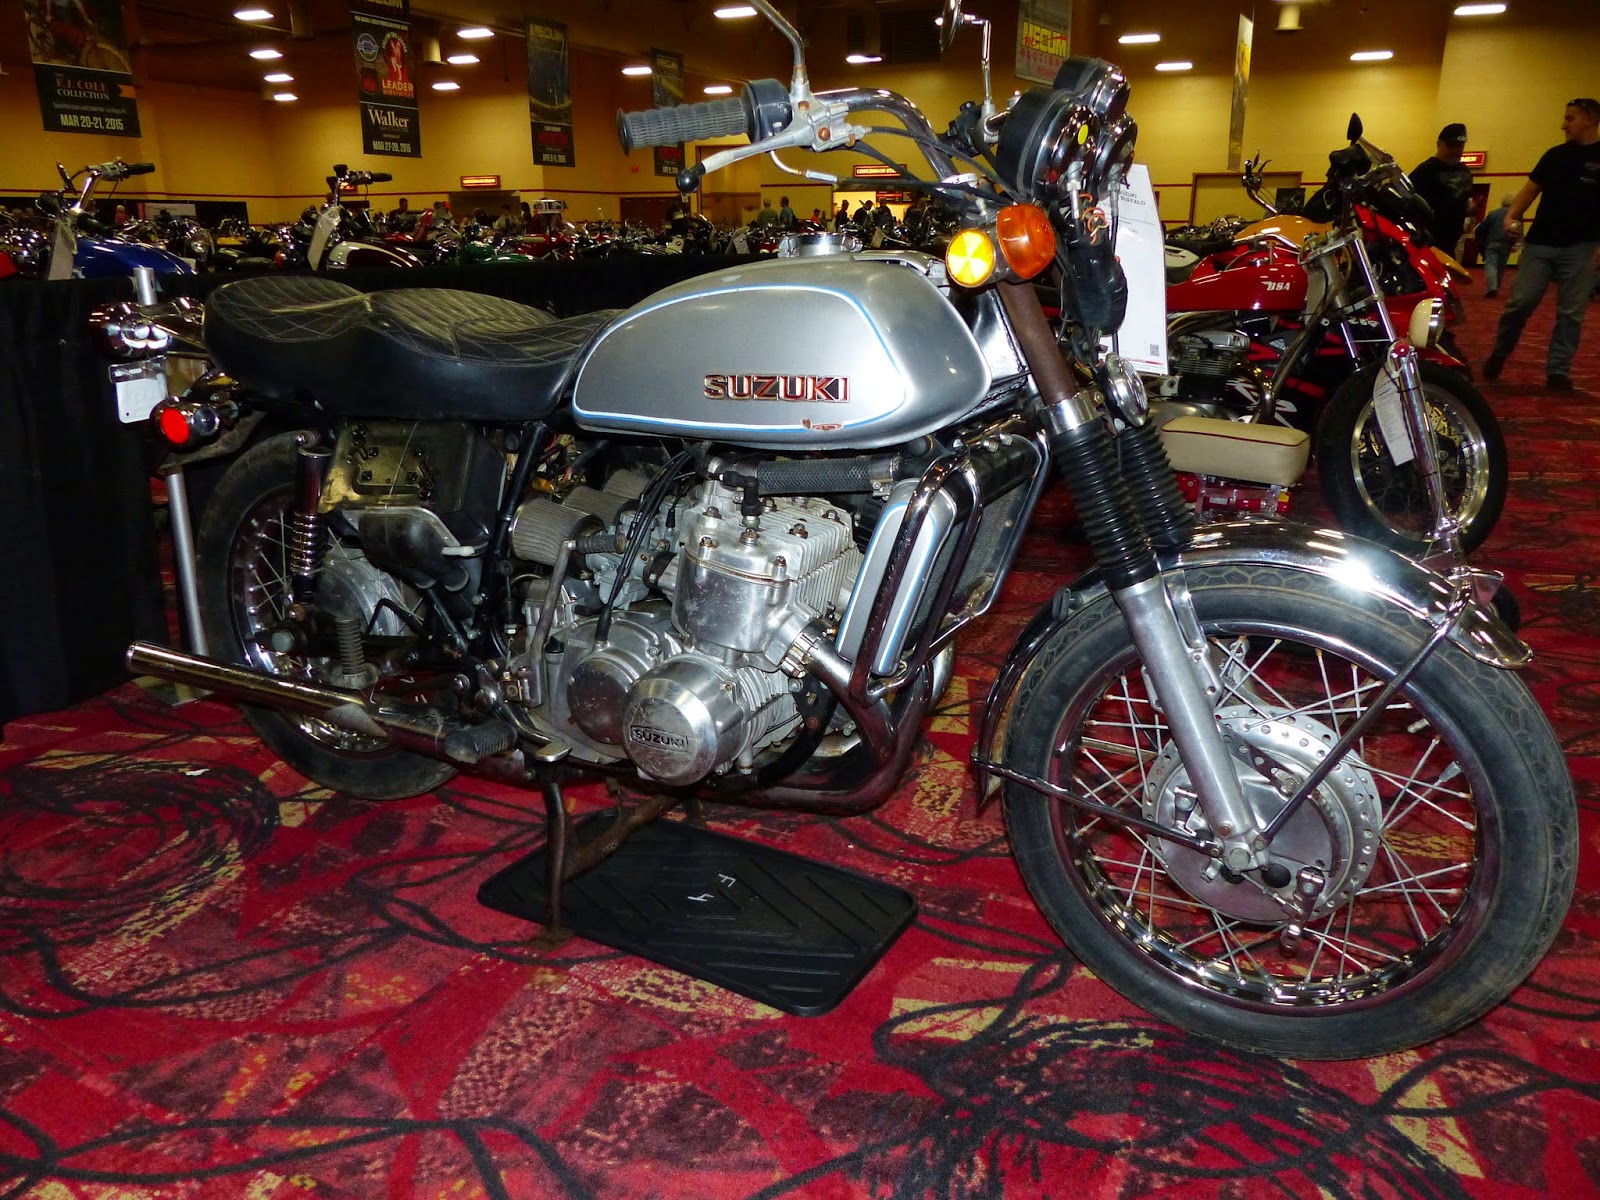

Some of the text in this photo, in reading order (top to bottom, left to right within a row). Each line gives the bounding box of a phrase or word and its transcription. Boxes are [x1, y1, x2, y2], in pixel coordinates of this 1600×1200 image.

[1022, 21, 1067, 59] MECUM
[57, 88, 110, 100] COLLECTION
[382, 79, 414, 92] LEADER
[60, 114, 124, 131] MAR 20-21, 2015
[367, 109, 409, 128] Walker
[1261, 281, 1291, 291] BSA
[703, 374, 850, 403] SUZUKI
[633, 729, 686, 748] SUZUKI
